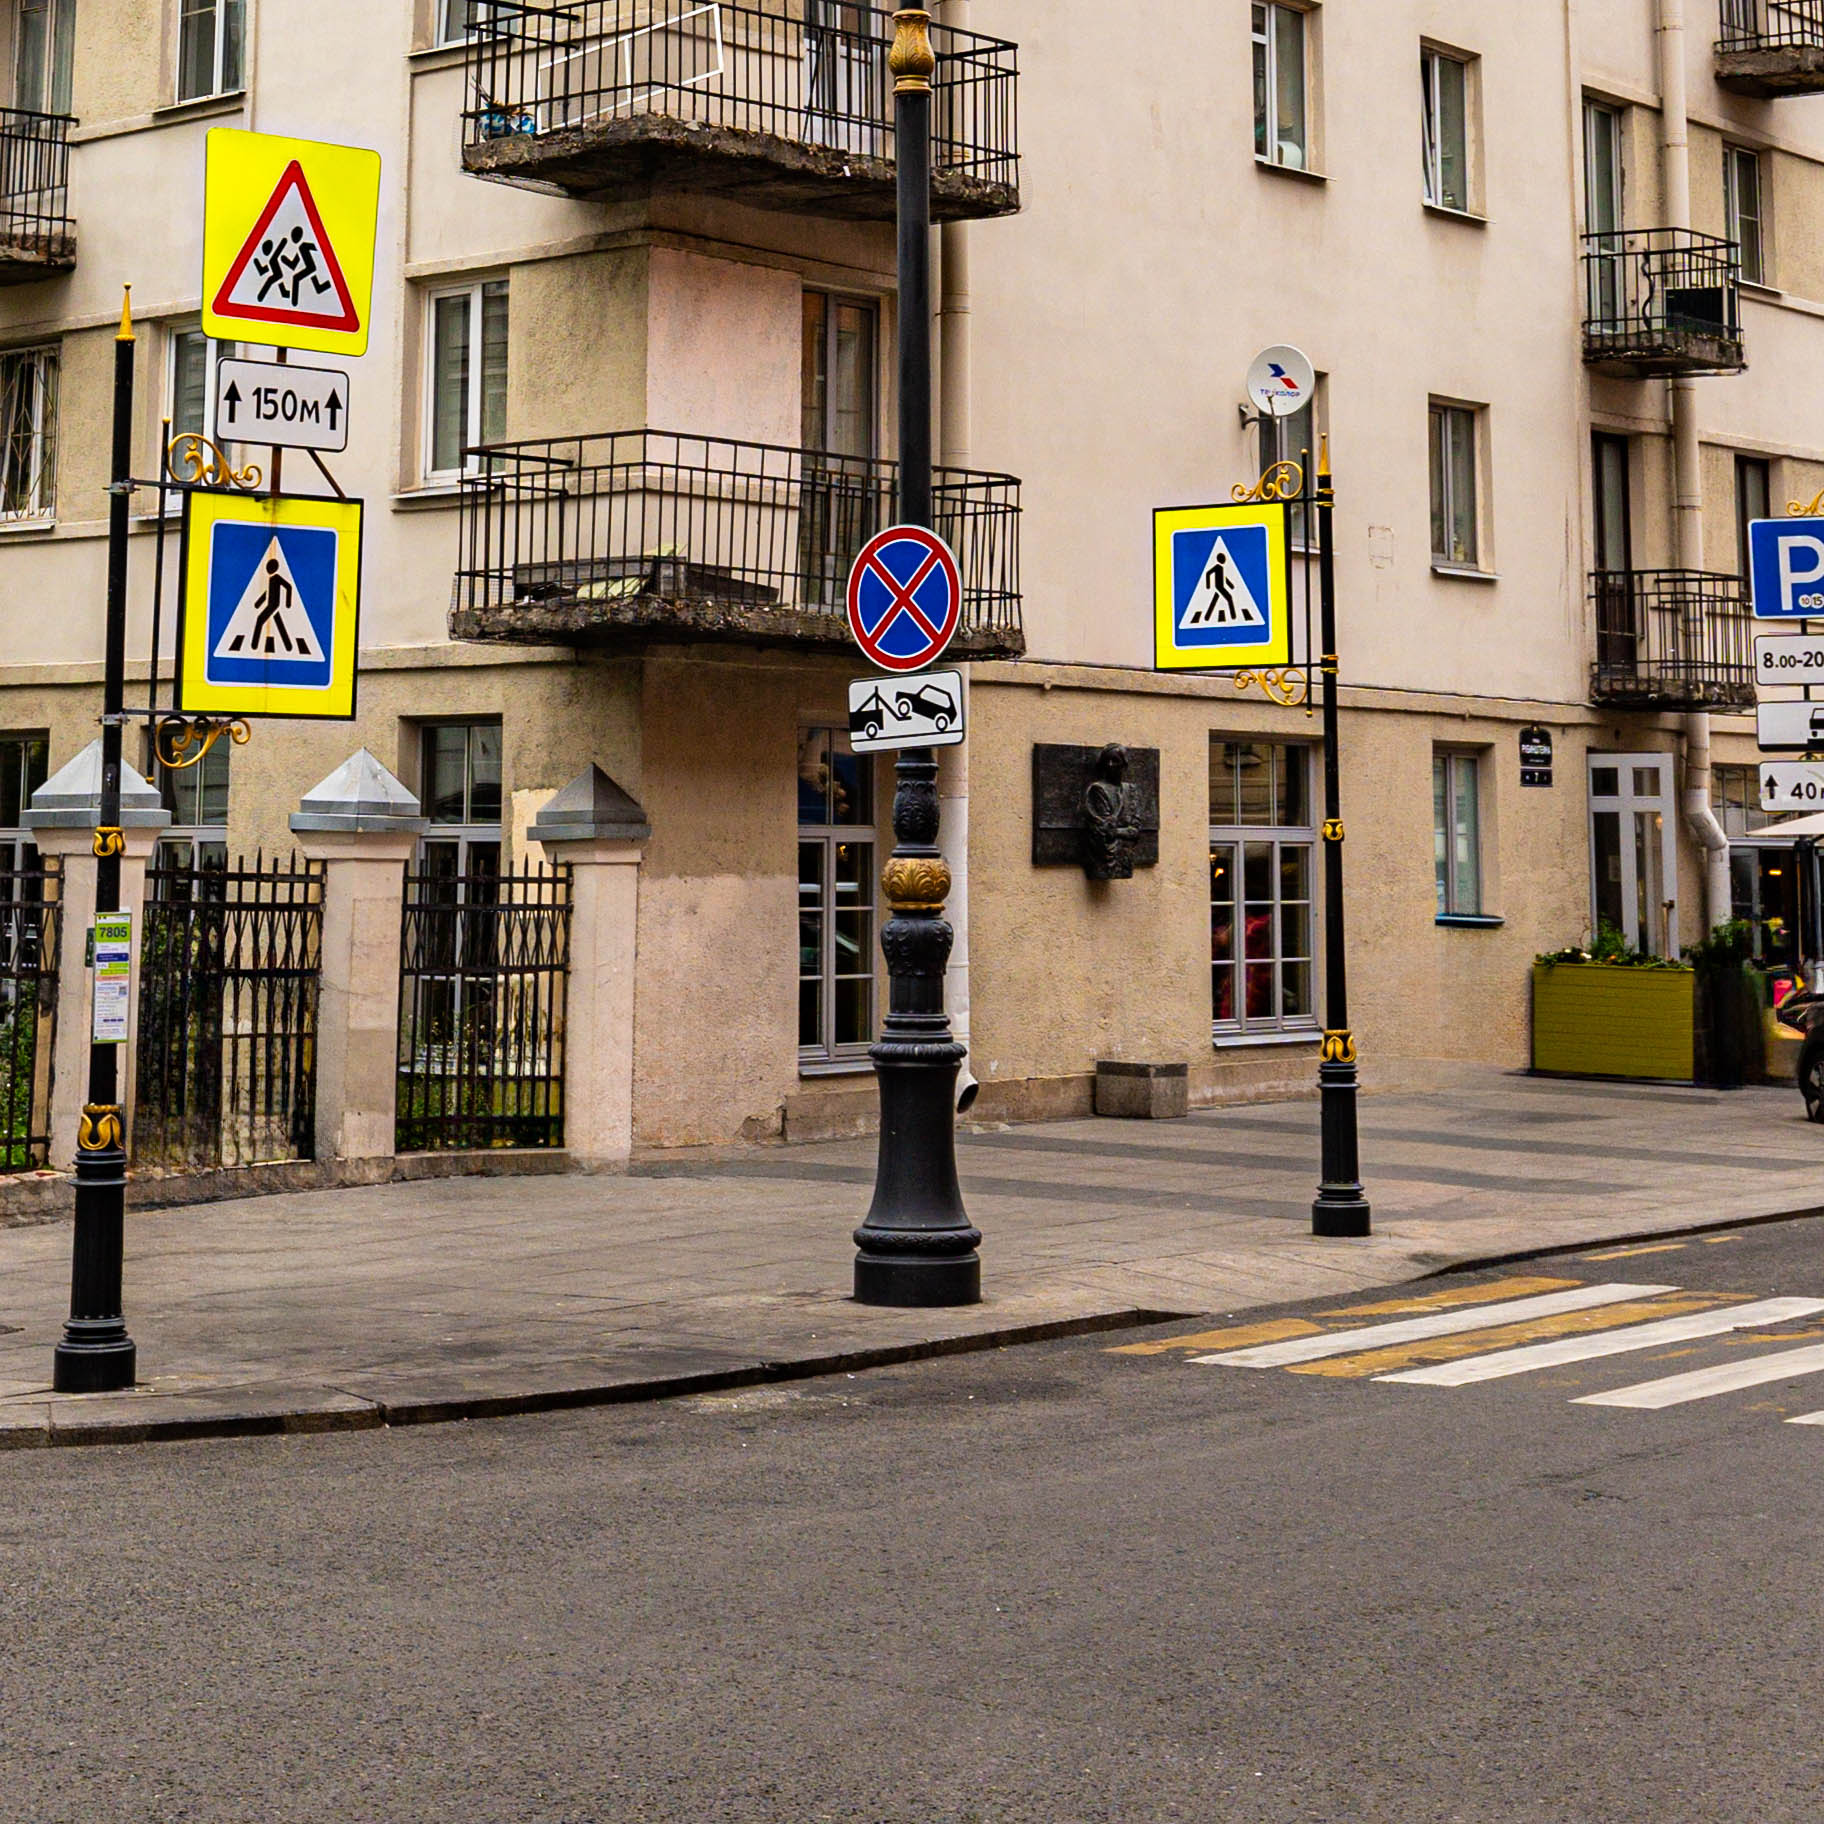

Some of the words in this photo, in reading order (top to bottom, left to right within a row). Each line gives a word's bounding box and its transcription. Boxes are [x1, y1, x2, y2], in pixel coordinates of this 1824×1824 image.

[252, 387, 320, 424] 150м
[1812, 596, 1823, 606] 15
[99, 926, 128, 938] 7805
